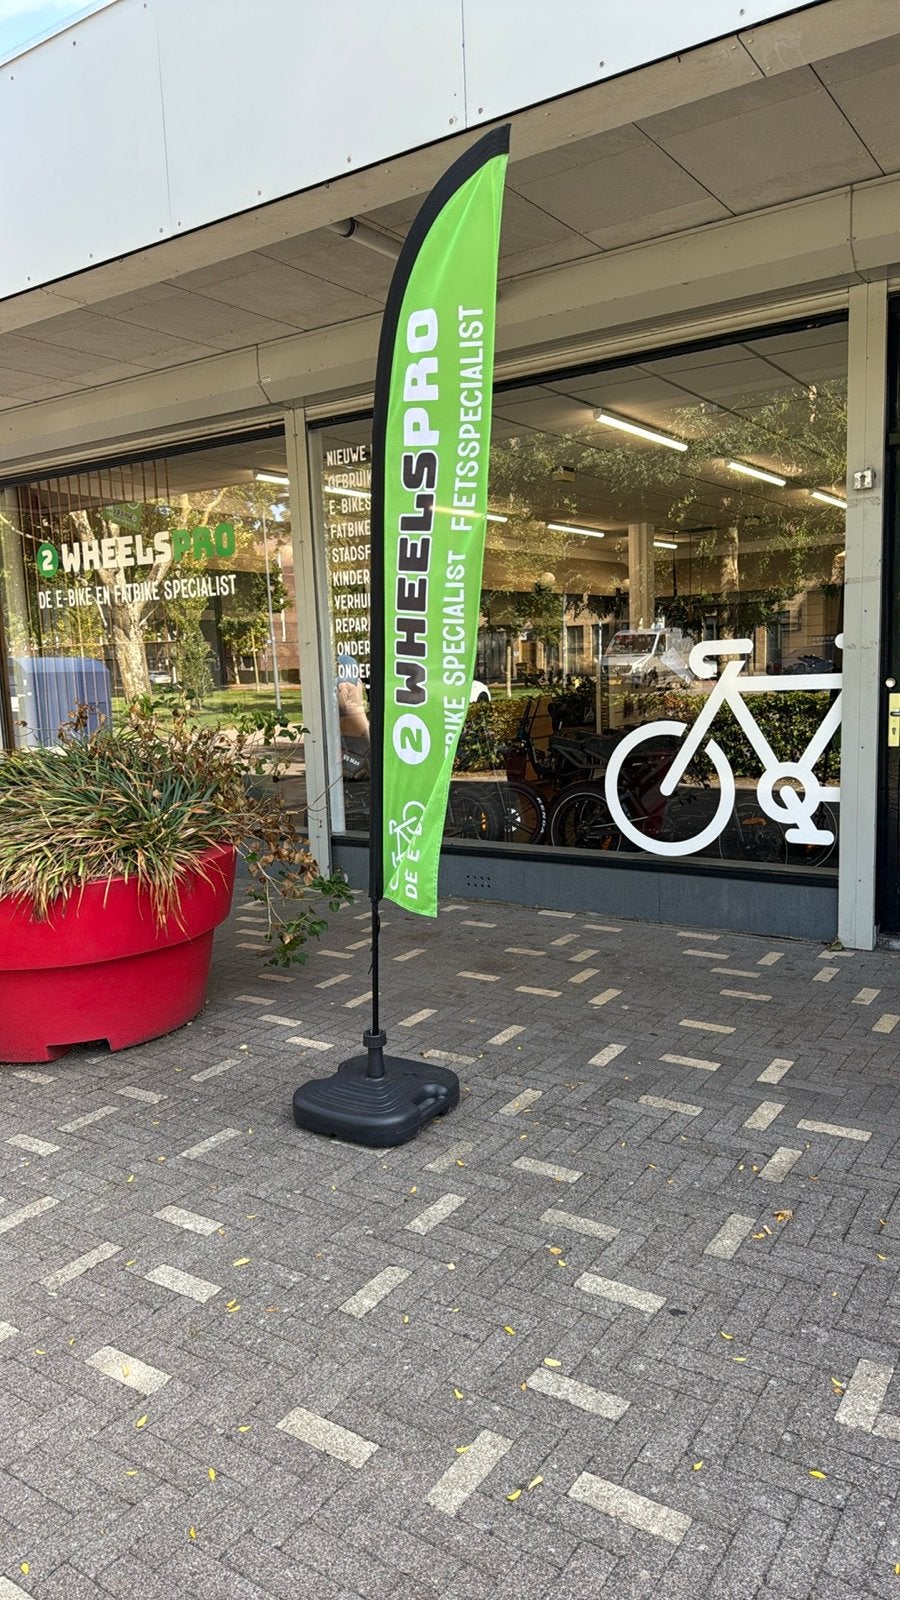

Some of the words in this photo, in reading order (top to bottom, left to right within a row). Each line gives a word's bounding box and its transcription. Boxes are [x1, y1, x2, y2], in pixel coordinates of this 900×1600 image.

[451, 305, 484, 531] FIETSSPECIALIST
[326, 444, 367, 467] NIEUWE
[329, 496, 371, 515] E-BIKES
[394, 308, 439, 707] WHEELSPRO
[330, 519, 371, 539] FATBIKE
[61, 522, 236, 573] WHEELSPRO
[332, 544, 371, 563] STADSF
[333, 568, 370, 588] KINDER
[38, 590, 53, 610] DE
[56, 587, 93, 609] E-BIKE
[96, 585, 111, 606] EN
[114, 580, 160, 603] FATBIKE
[164, 574, 237, 600] SPECIALIST
[442, 550, 466, 687] SPECIALIST
[337, 640, 370, 656] ONDER
[405, 868, 418, 900] DE
